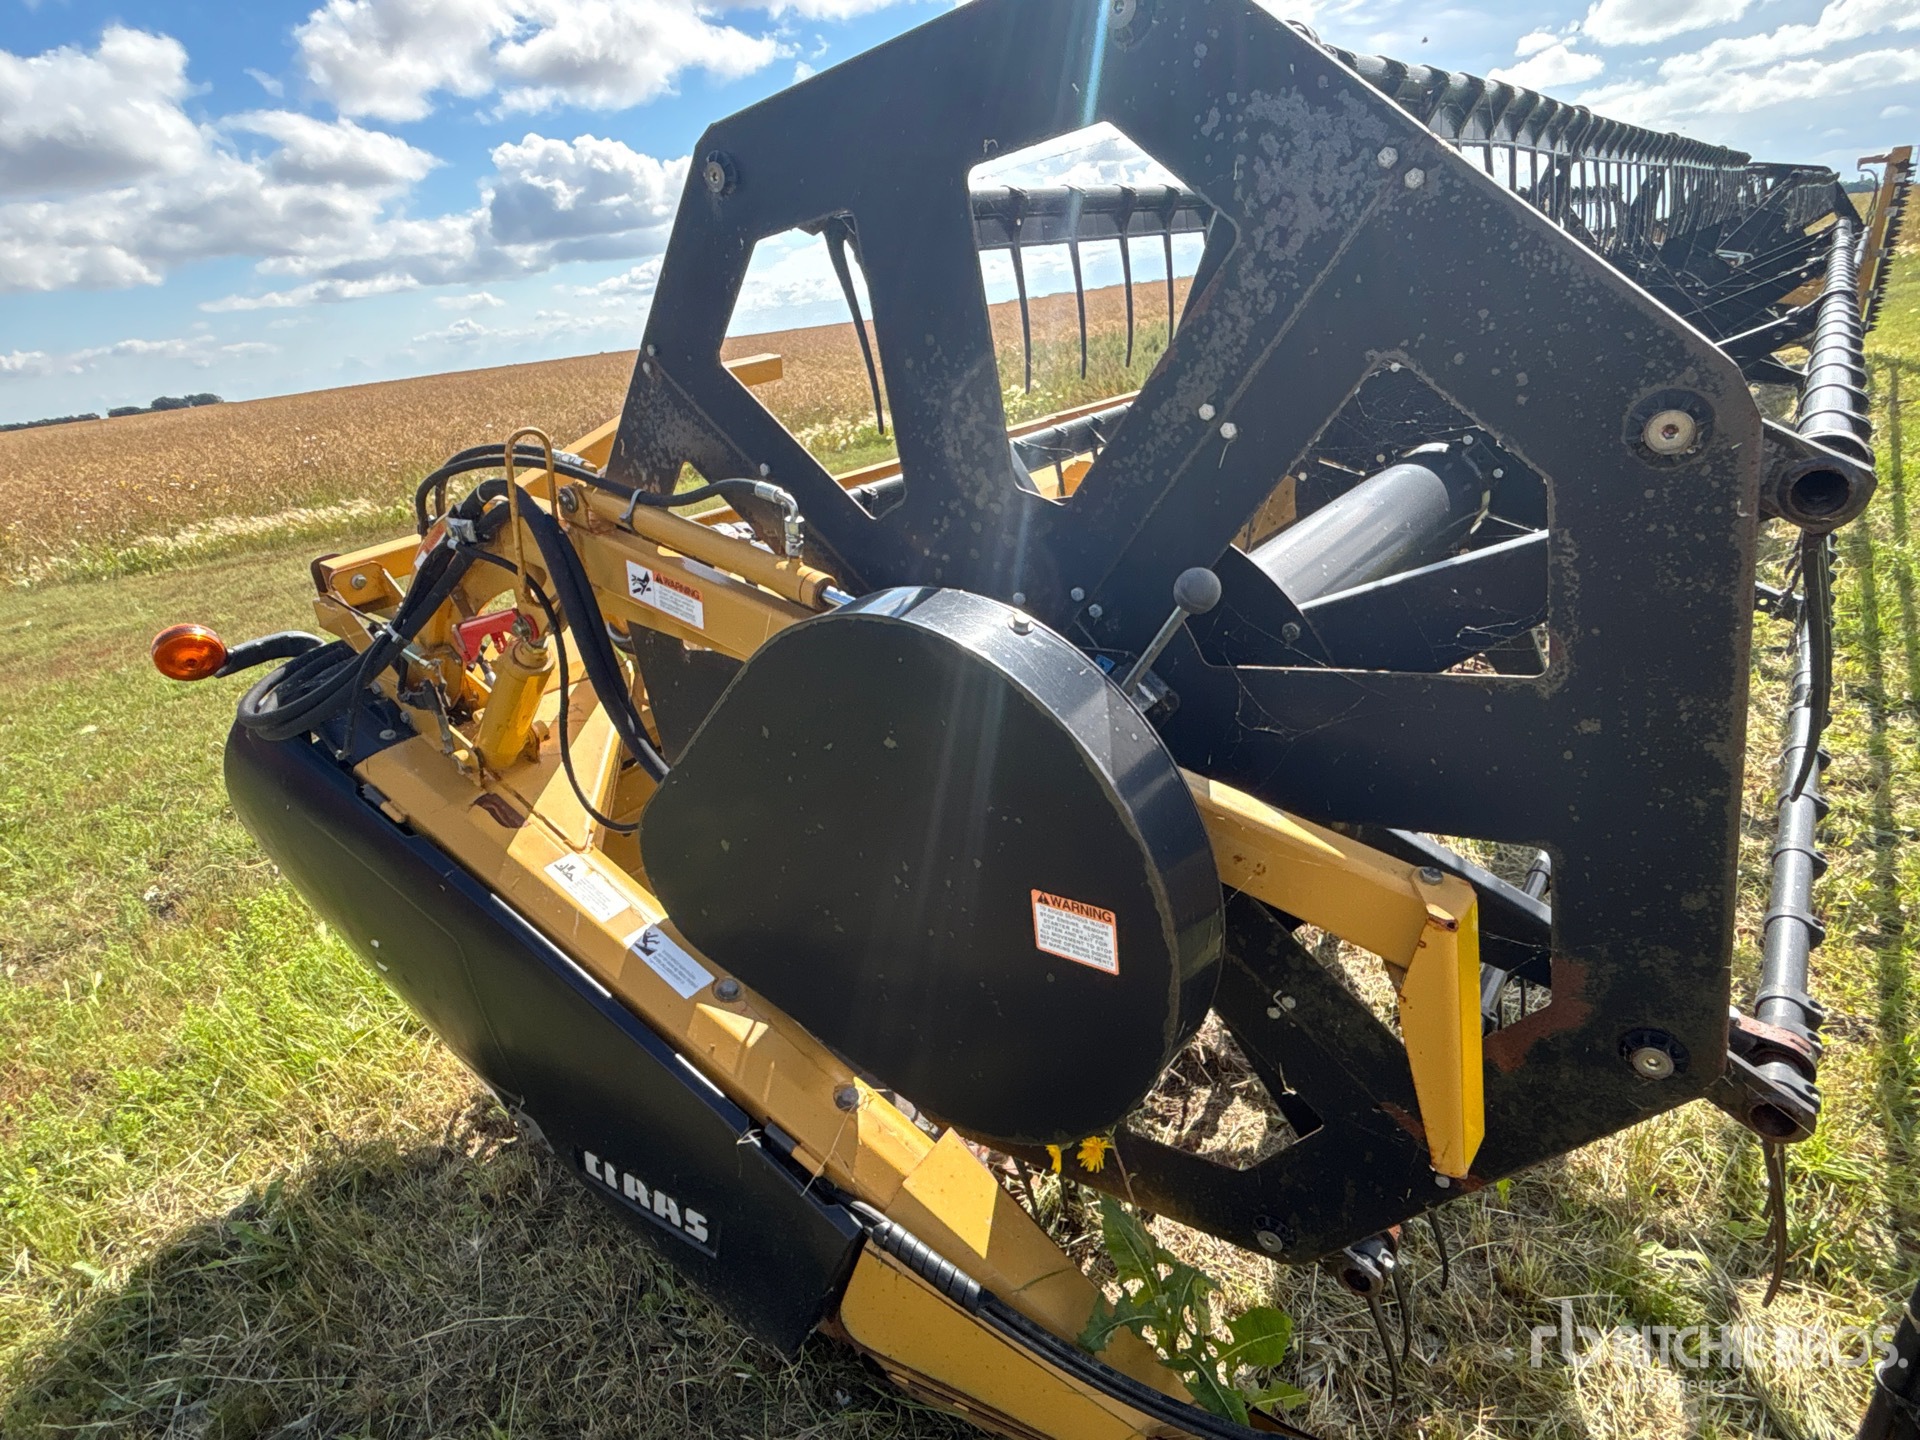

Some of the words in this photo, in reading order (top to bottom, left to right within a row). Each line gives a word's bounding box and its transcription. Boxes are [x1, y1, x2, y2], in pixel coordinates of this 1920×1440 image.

[1050, 895, 1112, 923] WARNING
[1051, 932, 1084, 945] MOVEMENT
[1096, 946, 1112, 954] STOP
[584, 1151, 708, 1243] CLAAS
